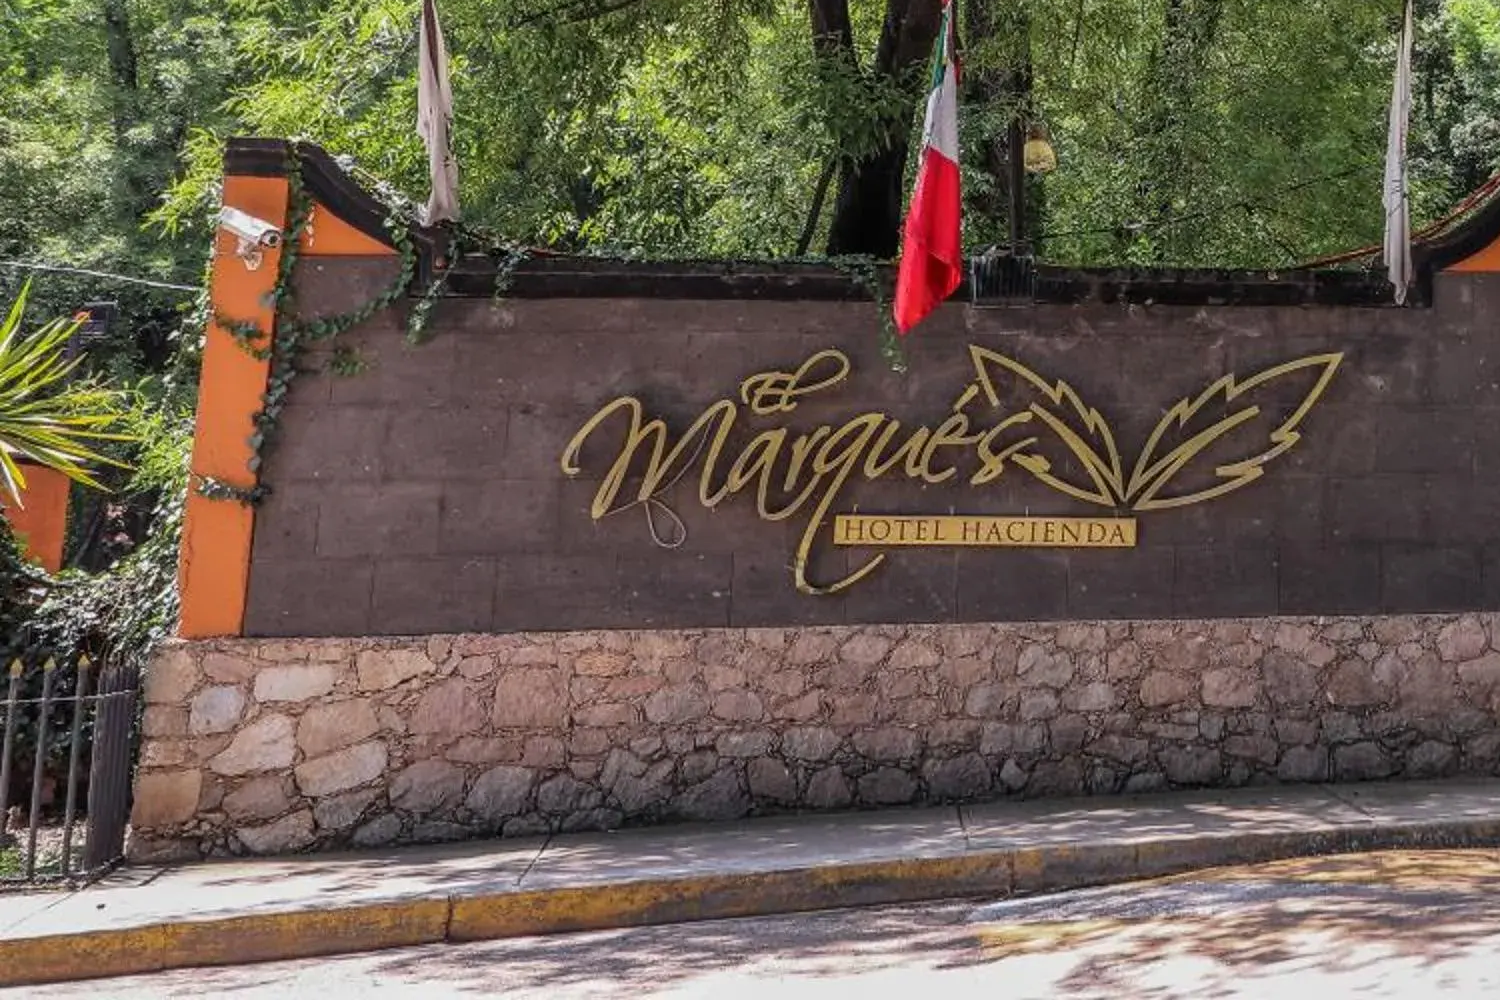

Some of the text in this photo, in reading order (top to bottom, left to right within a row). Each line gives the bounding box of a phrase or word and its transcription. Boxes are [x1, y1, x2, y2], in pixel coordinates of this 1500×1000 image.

[739, 348, 850, 415] El
[560, 383, 1038, 595] Marqués
[843, 519, 1127, 544] HOTEL HACIENDA
